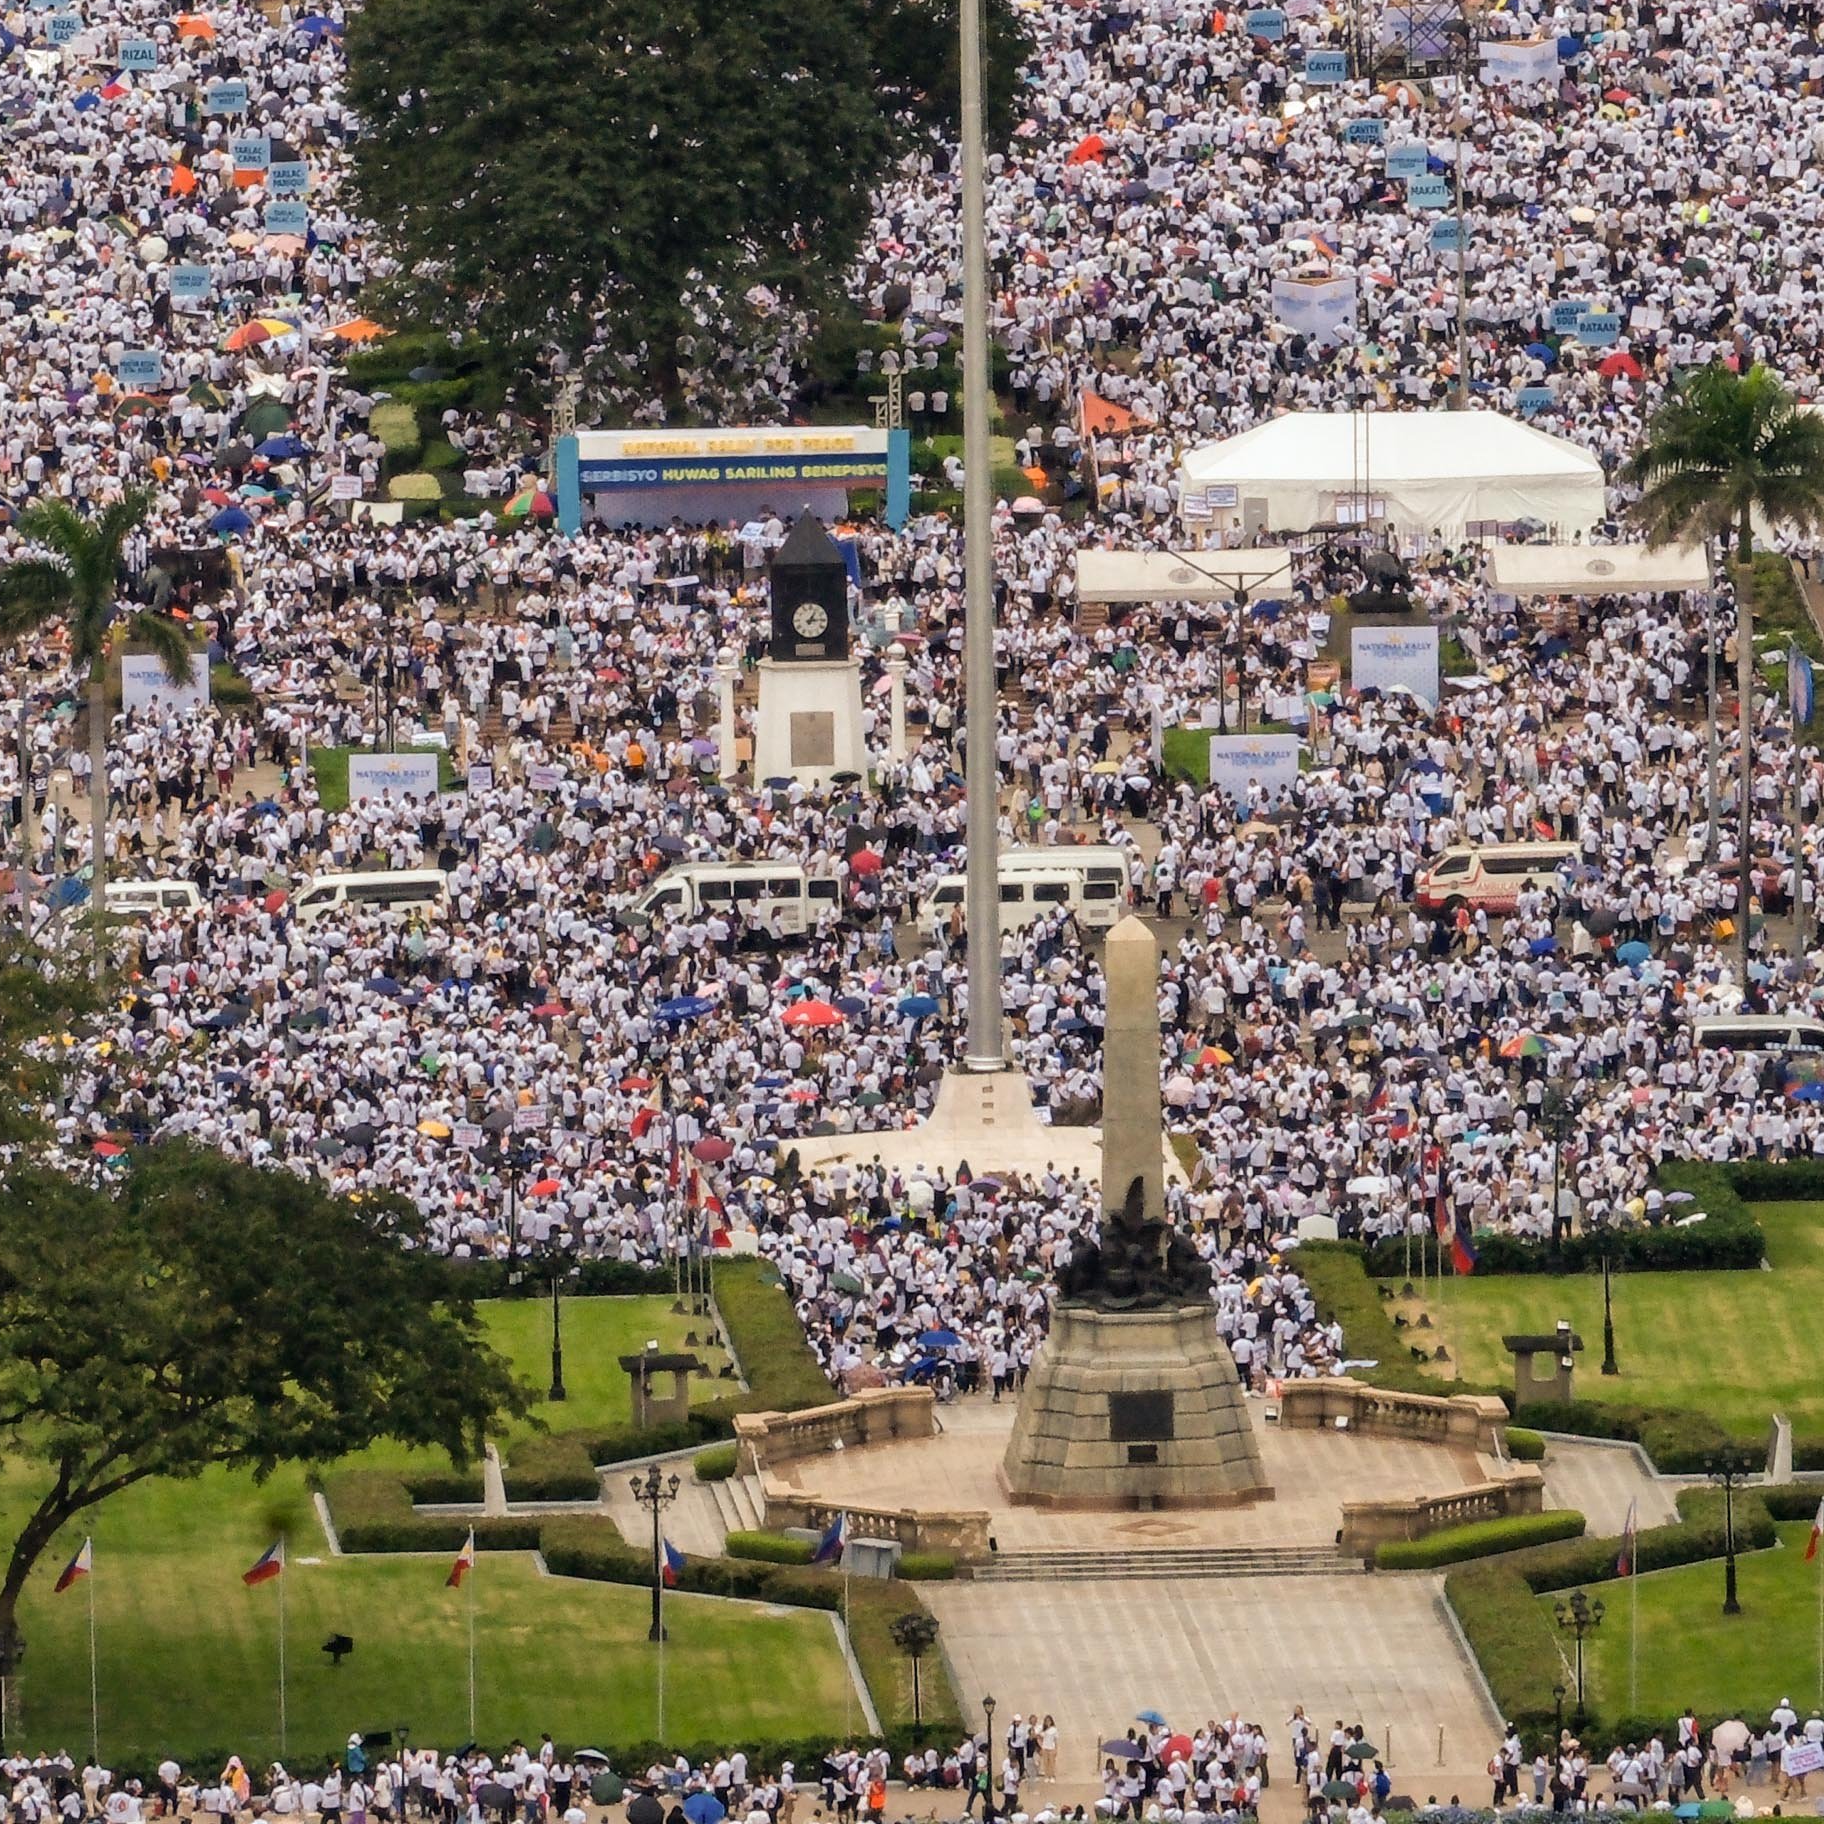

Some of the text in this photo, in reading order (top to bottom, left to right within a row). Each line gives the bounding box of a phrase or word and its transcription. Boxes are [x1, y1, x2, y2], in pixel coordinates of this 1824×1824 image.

[52, 19, 76, 30] RIZAL
[122, 49, 155, 61] RIZAL
[1308, 61, 1342, 72] CAVITE
[1349, 125, 1379, 134] CAVITE
[1411, 185, 1445, 196] MAKATI
[1433, 228, 1468, 238] AUROA
[1555, 307, 1587, 315] BATAAN
[1557, 316, 1578, 325] SOUT
[1579, 321, 1616, 332] BATAAN
[622, 439, 698, 455] NATIONAL
[763, 437, 793, 452] FOR
[580, 462, 888, 483] SERBISYO HUWAG SARILING BENEPISYO
[1359, 642, 1431, 651] NATIONAL RALLY
[1217, 751, 1291, 759] NATIONAL RALLY
[356, 770, 430, 778] NATIONAL RALLY
